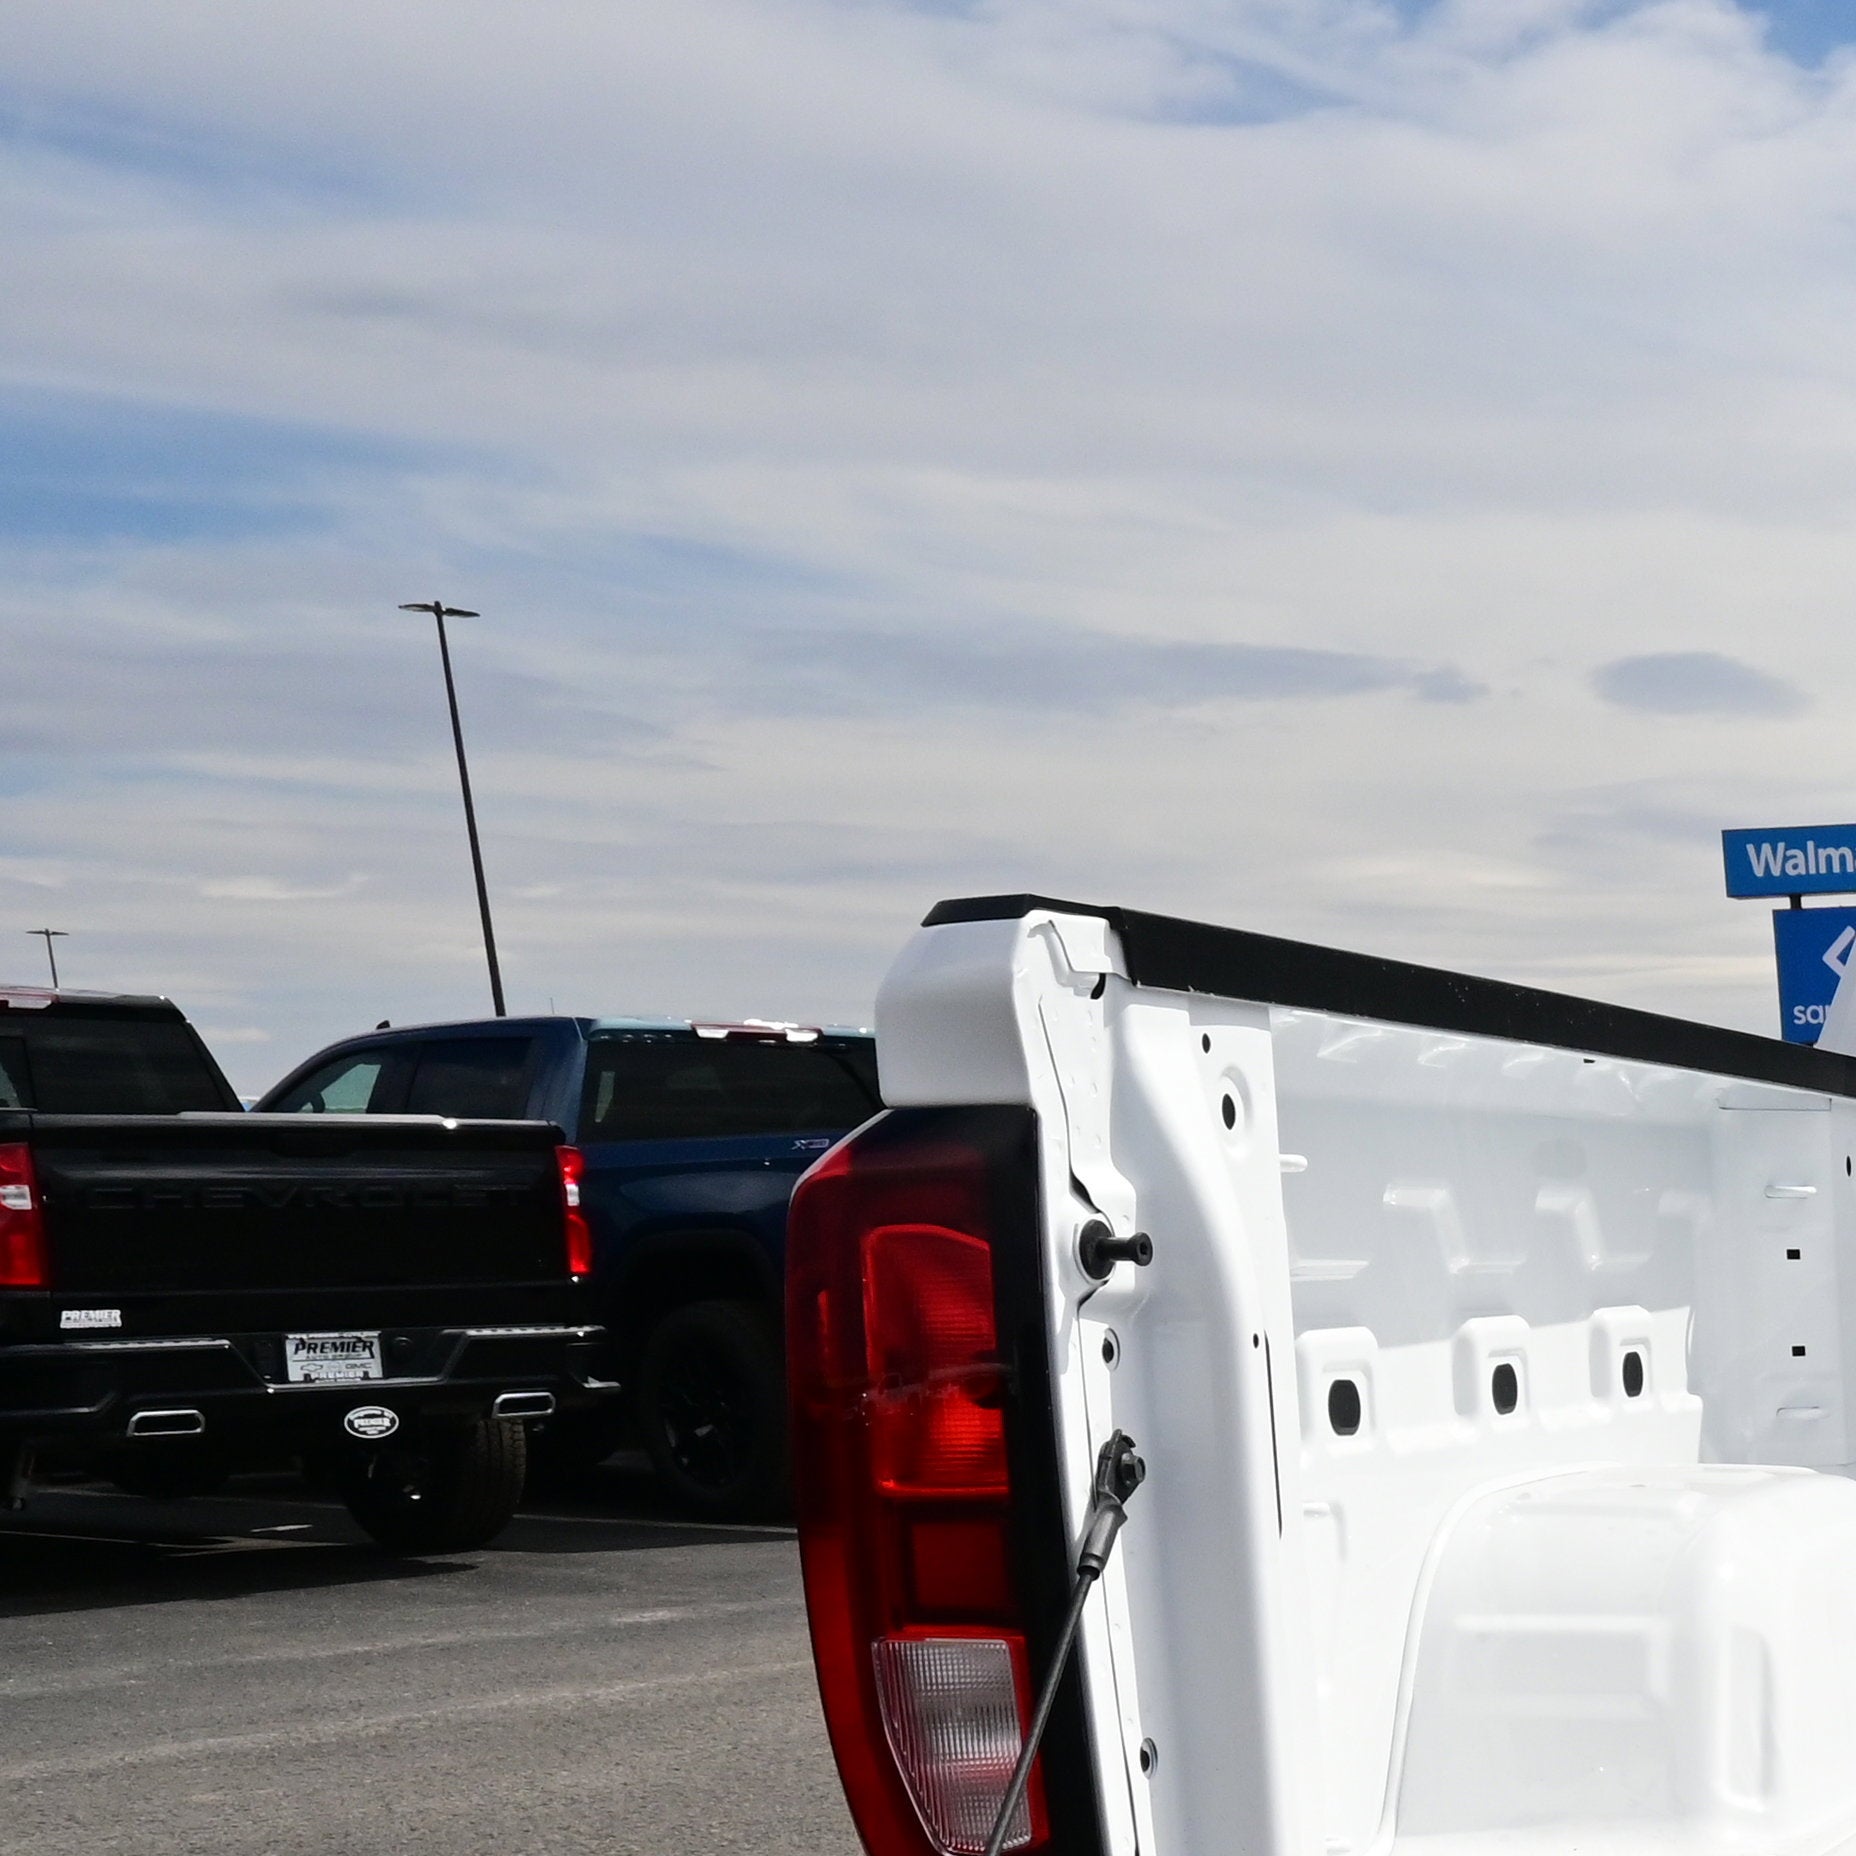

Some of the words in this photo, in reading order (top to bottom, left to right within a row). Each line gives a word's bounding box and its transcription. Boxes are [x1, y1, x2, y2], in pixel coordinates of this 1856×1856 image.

[1793, 1004, 1831, 1025] sa
[88, 1184, 532, 1209] CHEVROLET
[294, 1340, 375, 1359] PREMIER
